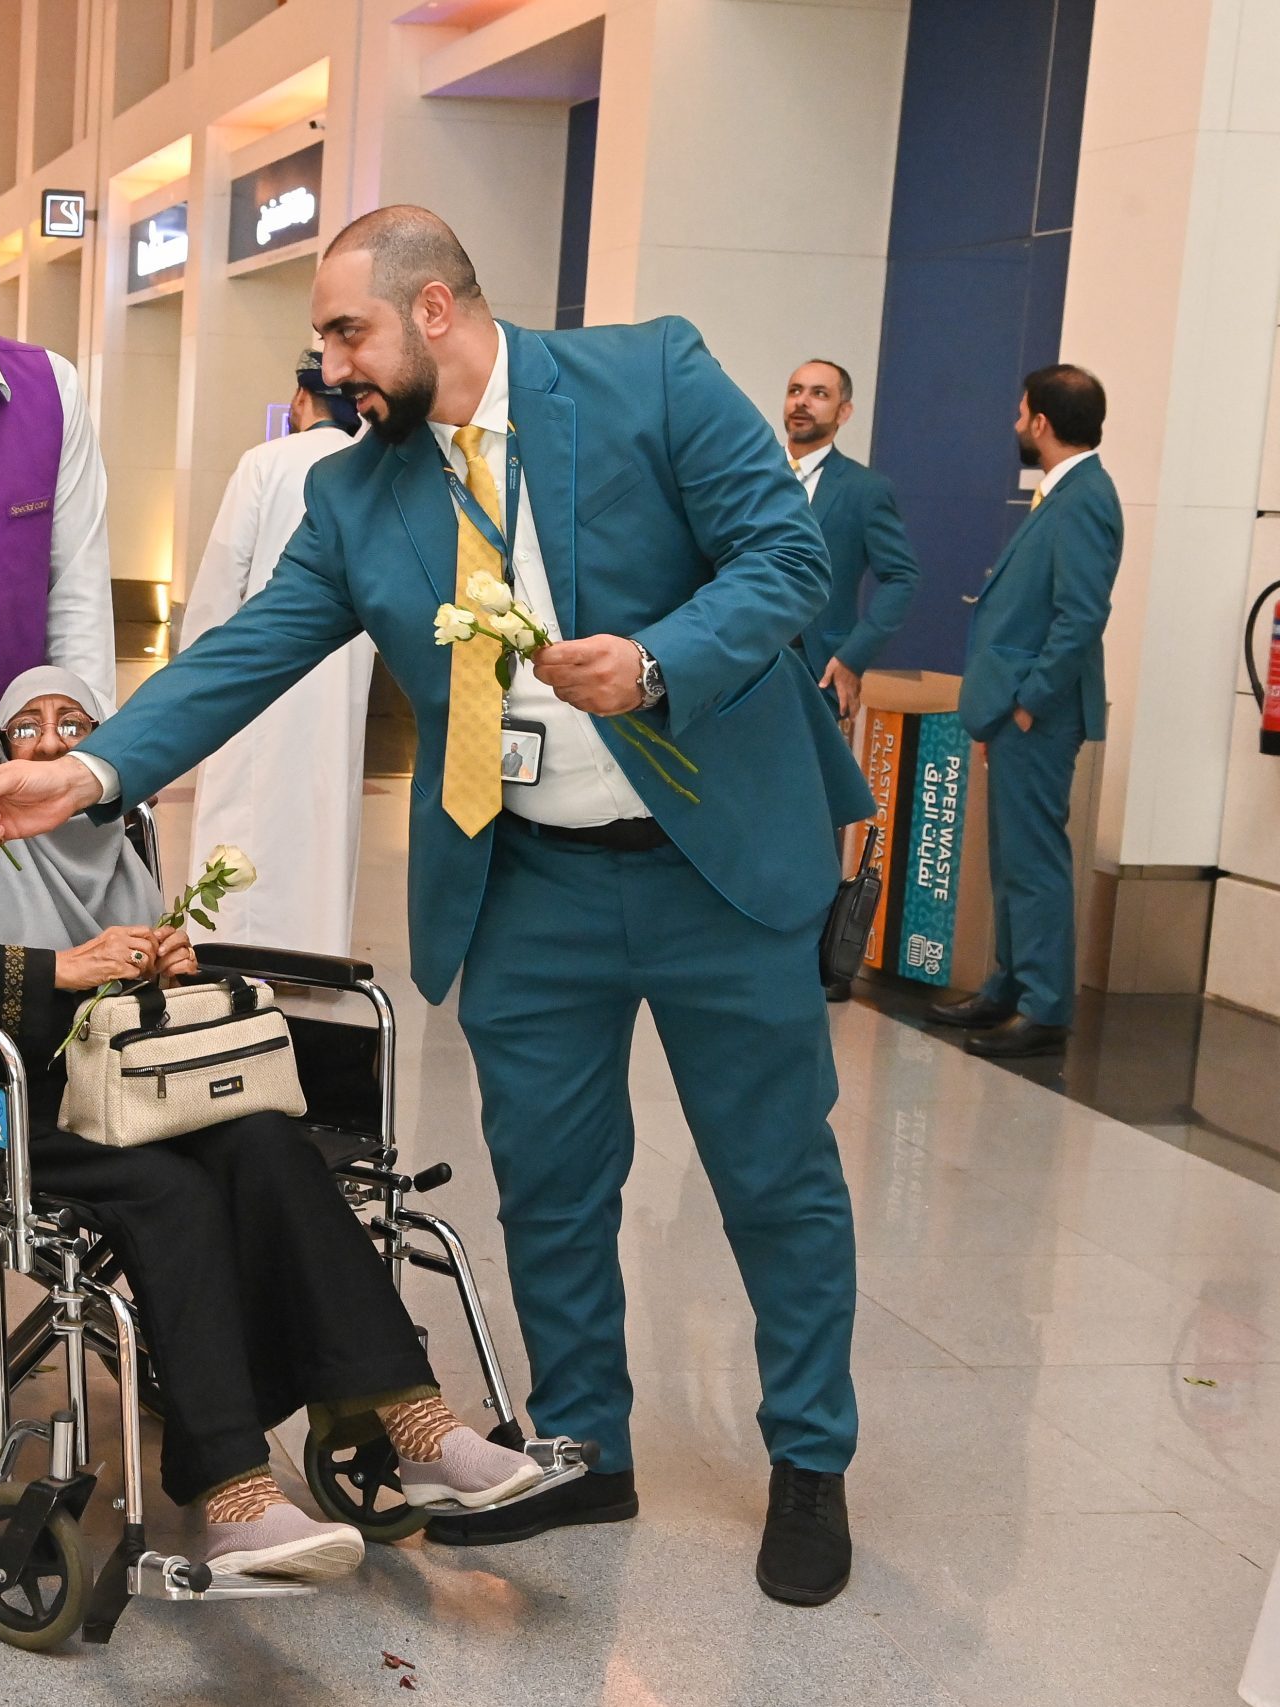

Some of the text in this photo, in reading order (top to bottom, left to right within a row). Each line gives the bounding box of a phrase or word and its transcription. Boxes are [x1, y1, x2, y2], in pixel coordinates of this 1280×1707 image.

[876, 731, 895, 823] PLASTIC
[917, 762, 943, 888] نفايات الورق
[933, 755, 961, 901] PAPER WASTE
